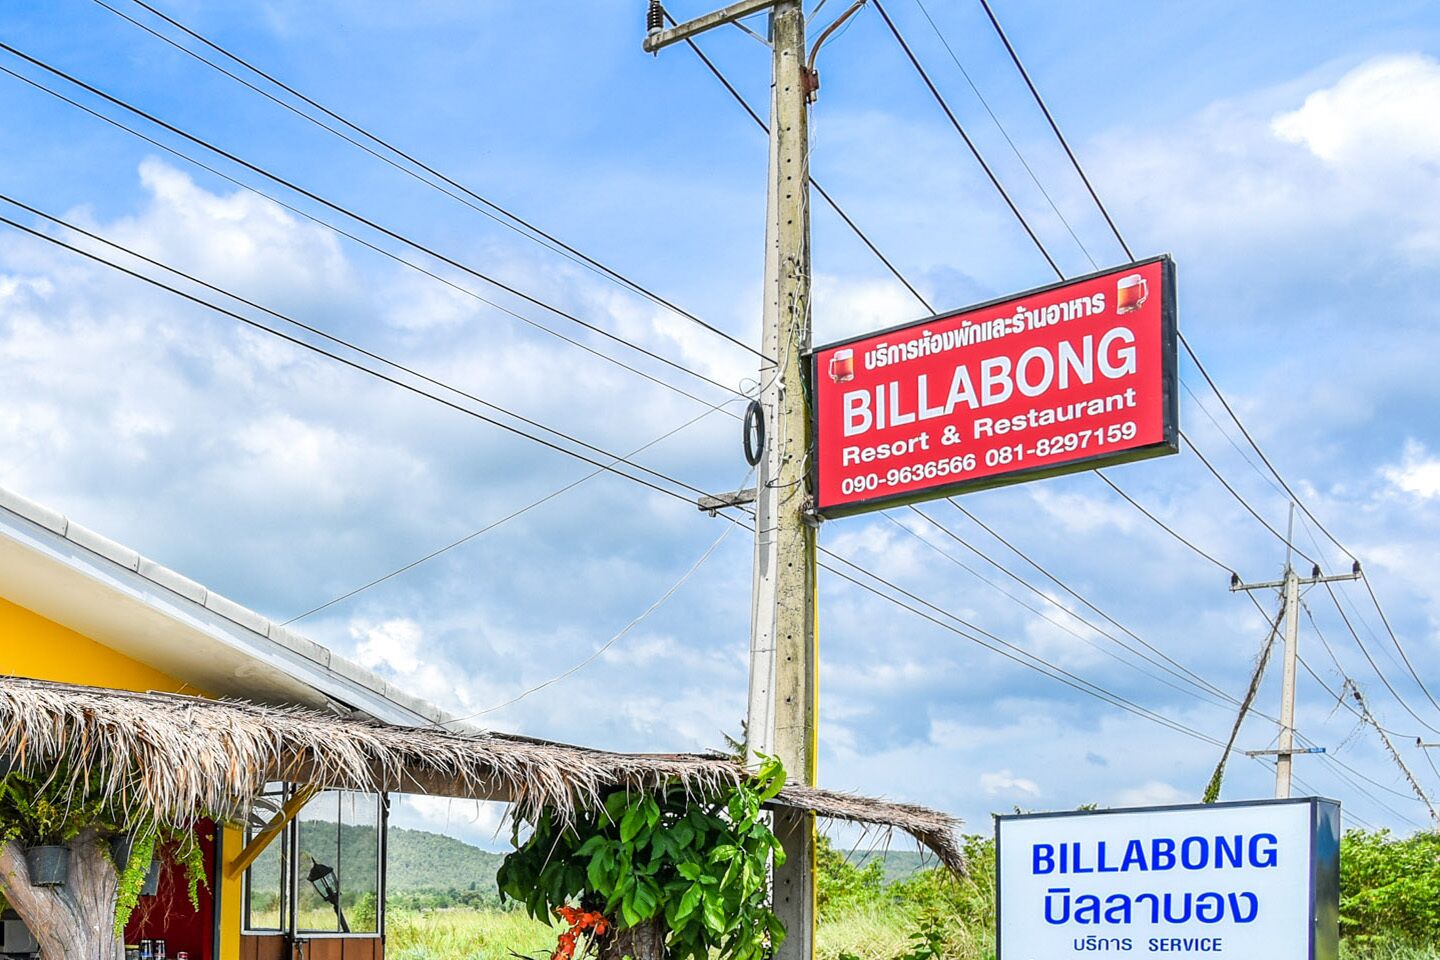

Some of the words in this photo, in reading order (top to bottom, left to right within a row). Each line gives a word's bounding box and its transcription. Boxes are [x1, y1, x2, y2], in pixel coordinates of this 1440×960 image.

[864, 292, 1106, 370] บริการห้องพักและร้านอาหาร
[843, 327, 1137, 438] BILLABONG
[841, 453, 977, 495] 090-9636566
[985, 421, 1137, 467] 081-8297159
[842, 431, 930, 467] Resort
[940, 425, 962, 446] &
[973, 387, 1137, 440] Restaurant
[1032, 832, 1278, 875] BILLABONG
[1044, 887, 1259, 925] บิลลาบอง
[1073, 935, 1133, 952] บริการ
[1148, 937, 1223, 952] SERVICE
